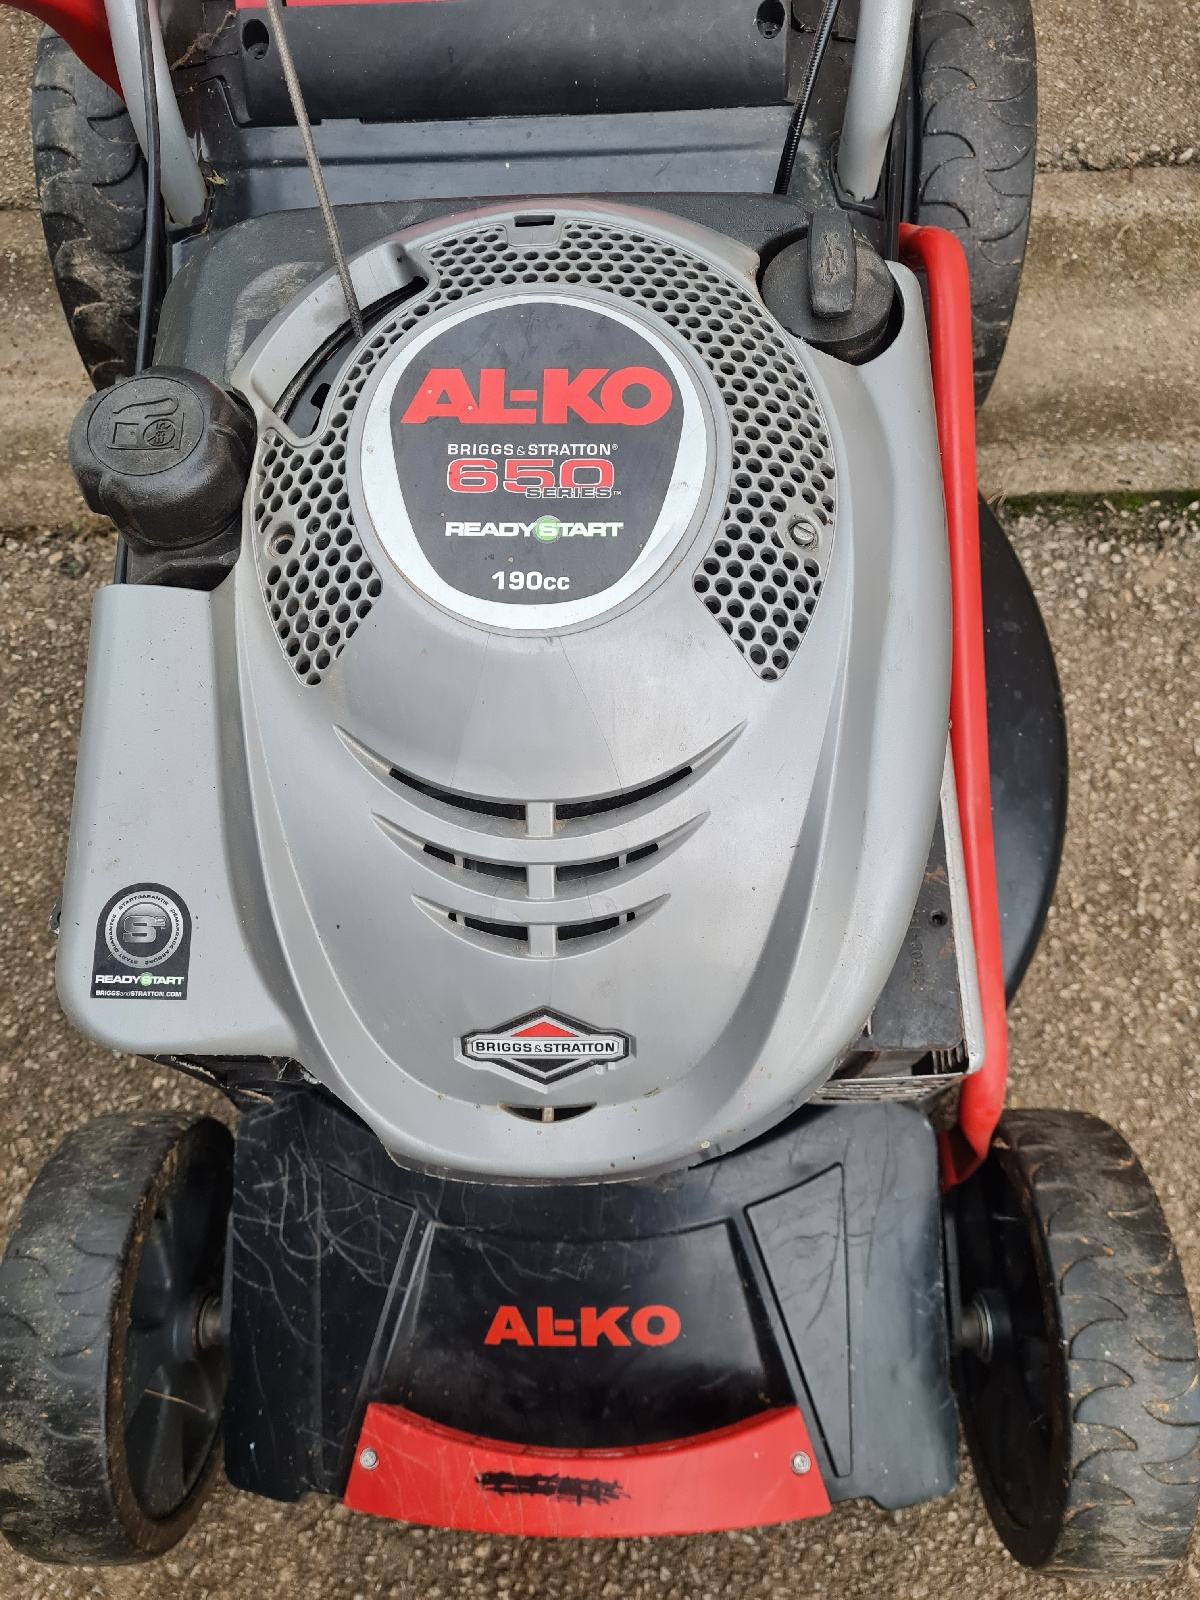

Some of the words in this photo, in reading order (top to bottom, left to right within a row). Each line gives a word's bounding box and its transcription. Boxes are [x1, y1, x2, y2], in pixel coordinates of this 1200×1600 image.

[400, 366, 673, 426] AL-KO
[446, 457, 615, 494] 650
[491, 571, 570, 590] 190cc
[484, 1304, 682, 1347] AL-KO
